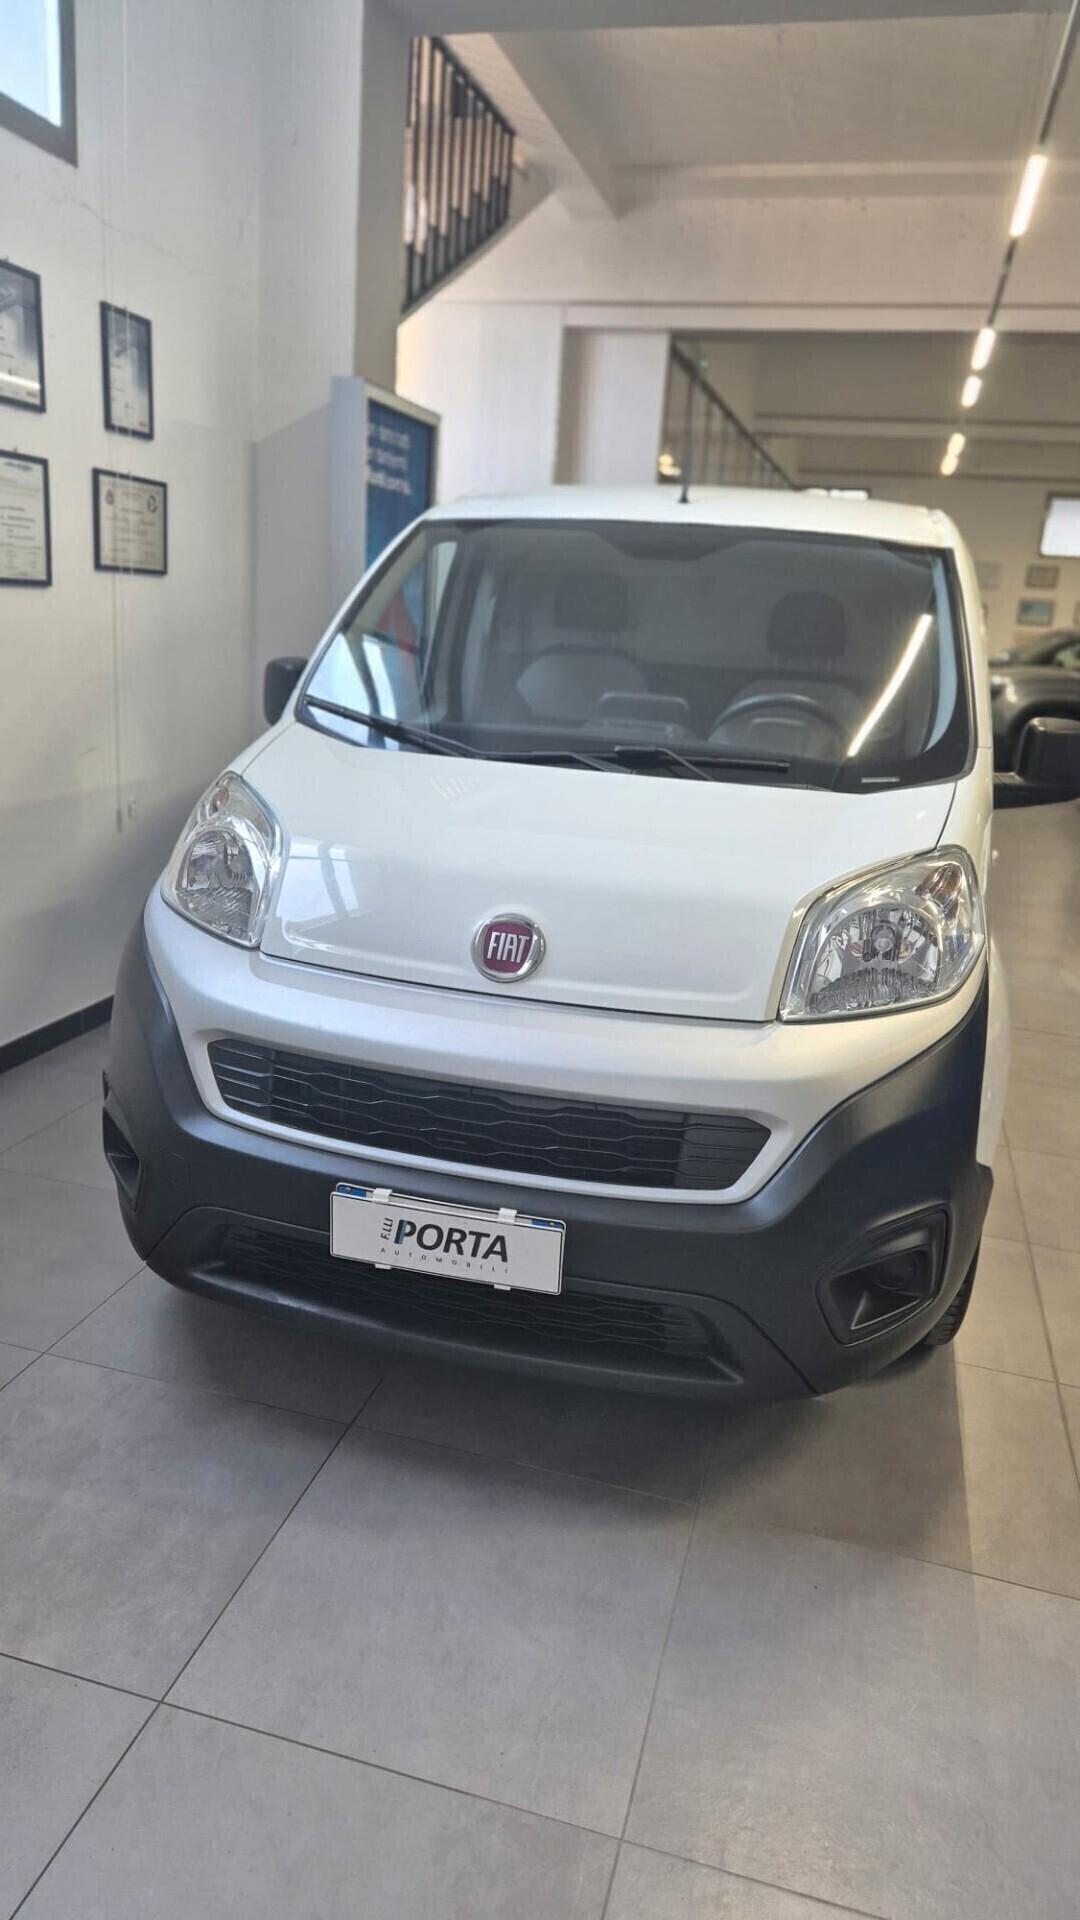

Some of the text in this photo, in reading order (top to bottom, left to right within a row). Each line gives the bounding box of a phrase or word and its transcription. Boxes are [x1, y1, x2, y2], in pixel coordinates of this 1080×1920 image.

[486, 931, 530, 963] FIAT
[394, 1218, 508, 1263] PORTA
[381, 1247, 508, 1274] AUTOMOBILI
